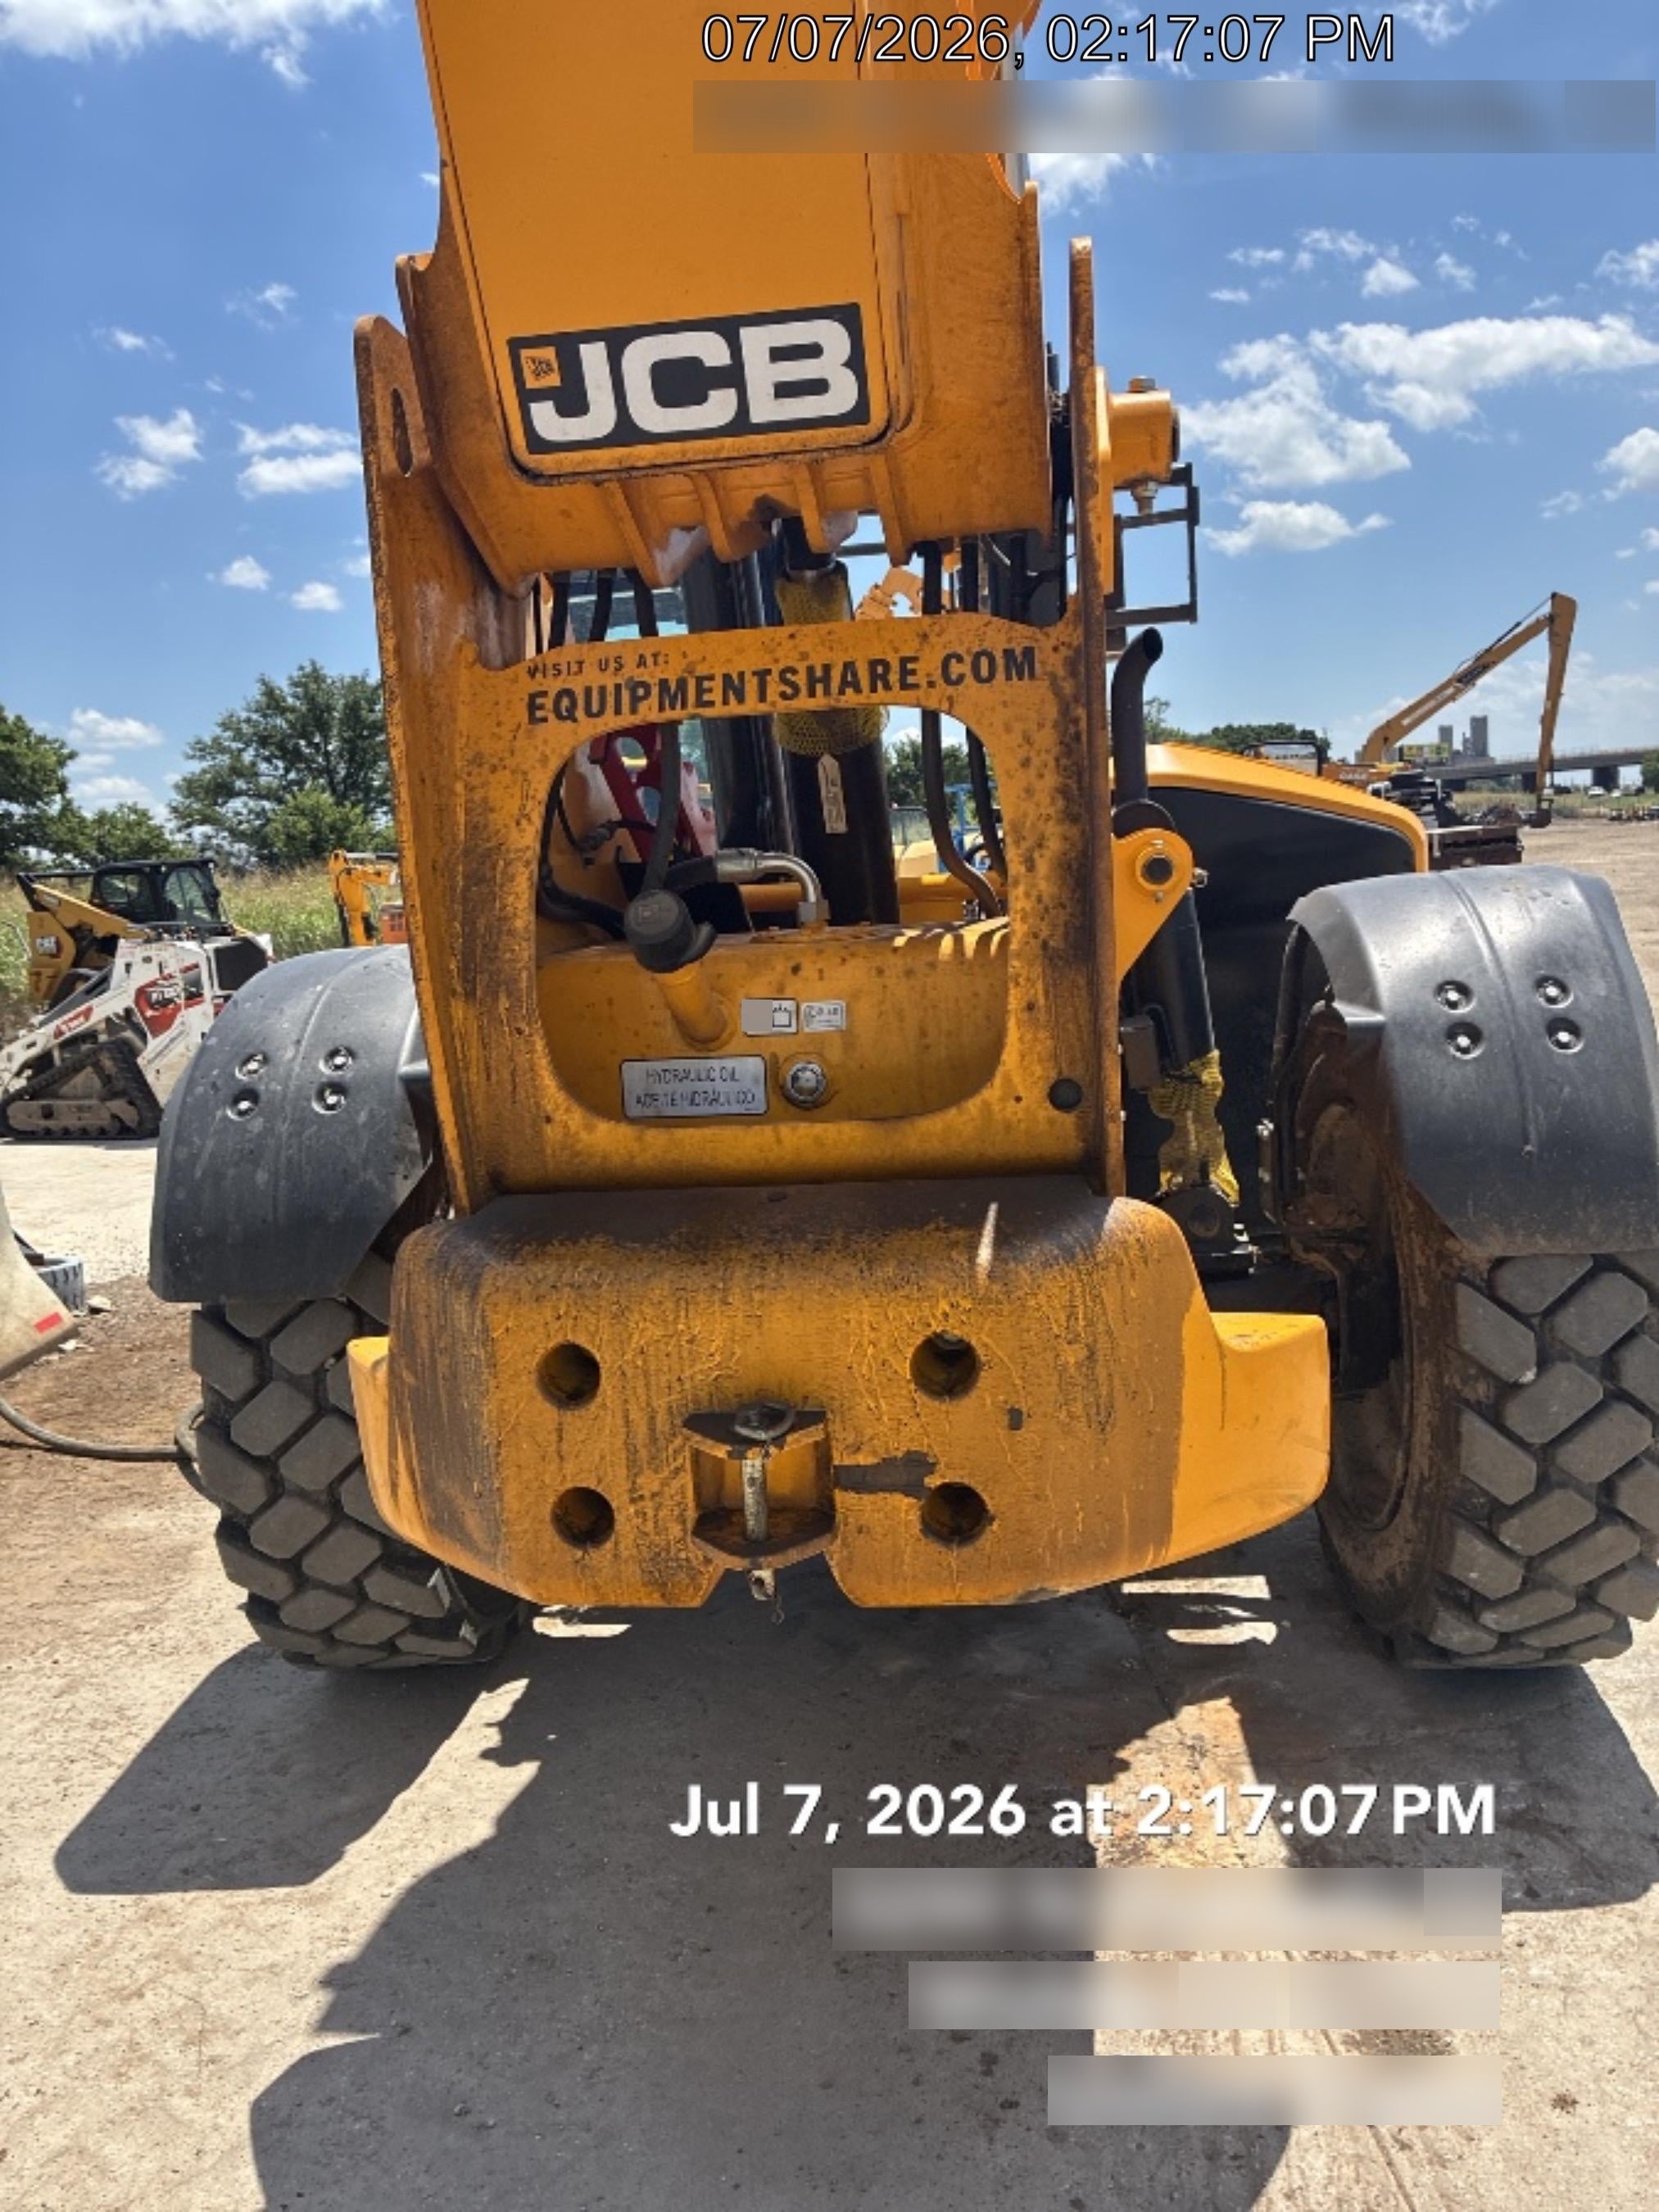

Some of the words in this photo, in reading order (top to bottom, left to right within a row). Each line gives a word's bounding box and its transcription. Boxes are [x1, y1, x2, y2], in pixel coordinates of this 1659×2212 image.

[529, 319, 859, 442] JCB
[527, 660, 586, 679] VISIT
[599, 655, 624, 673] US
[635, 651, 670, 669] AT:
[527, 646, 1036, 725] EQUIPMENTSHARE.COM
[646, 1067, 717, 1085] HYDRAULIC
[719, 1066, 741, 1082] OIL
